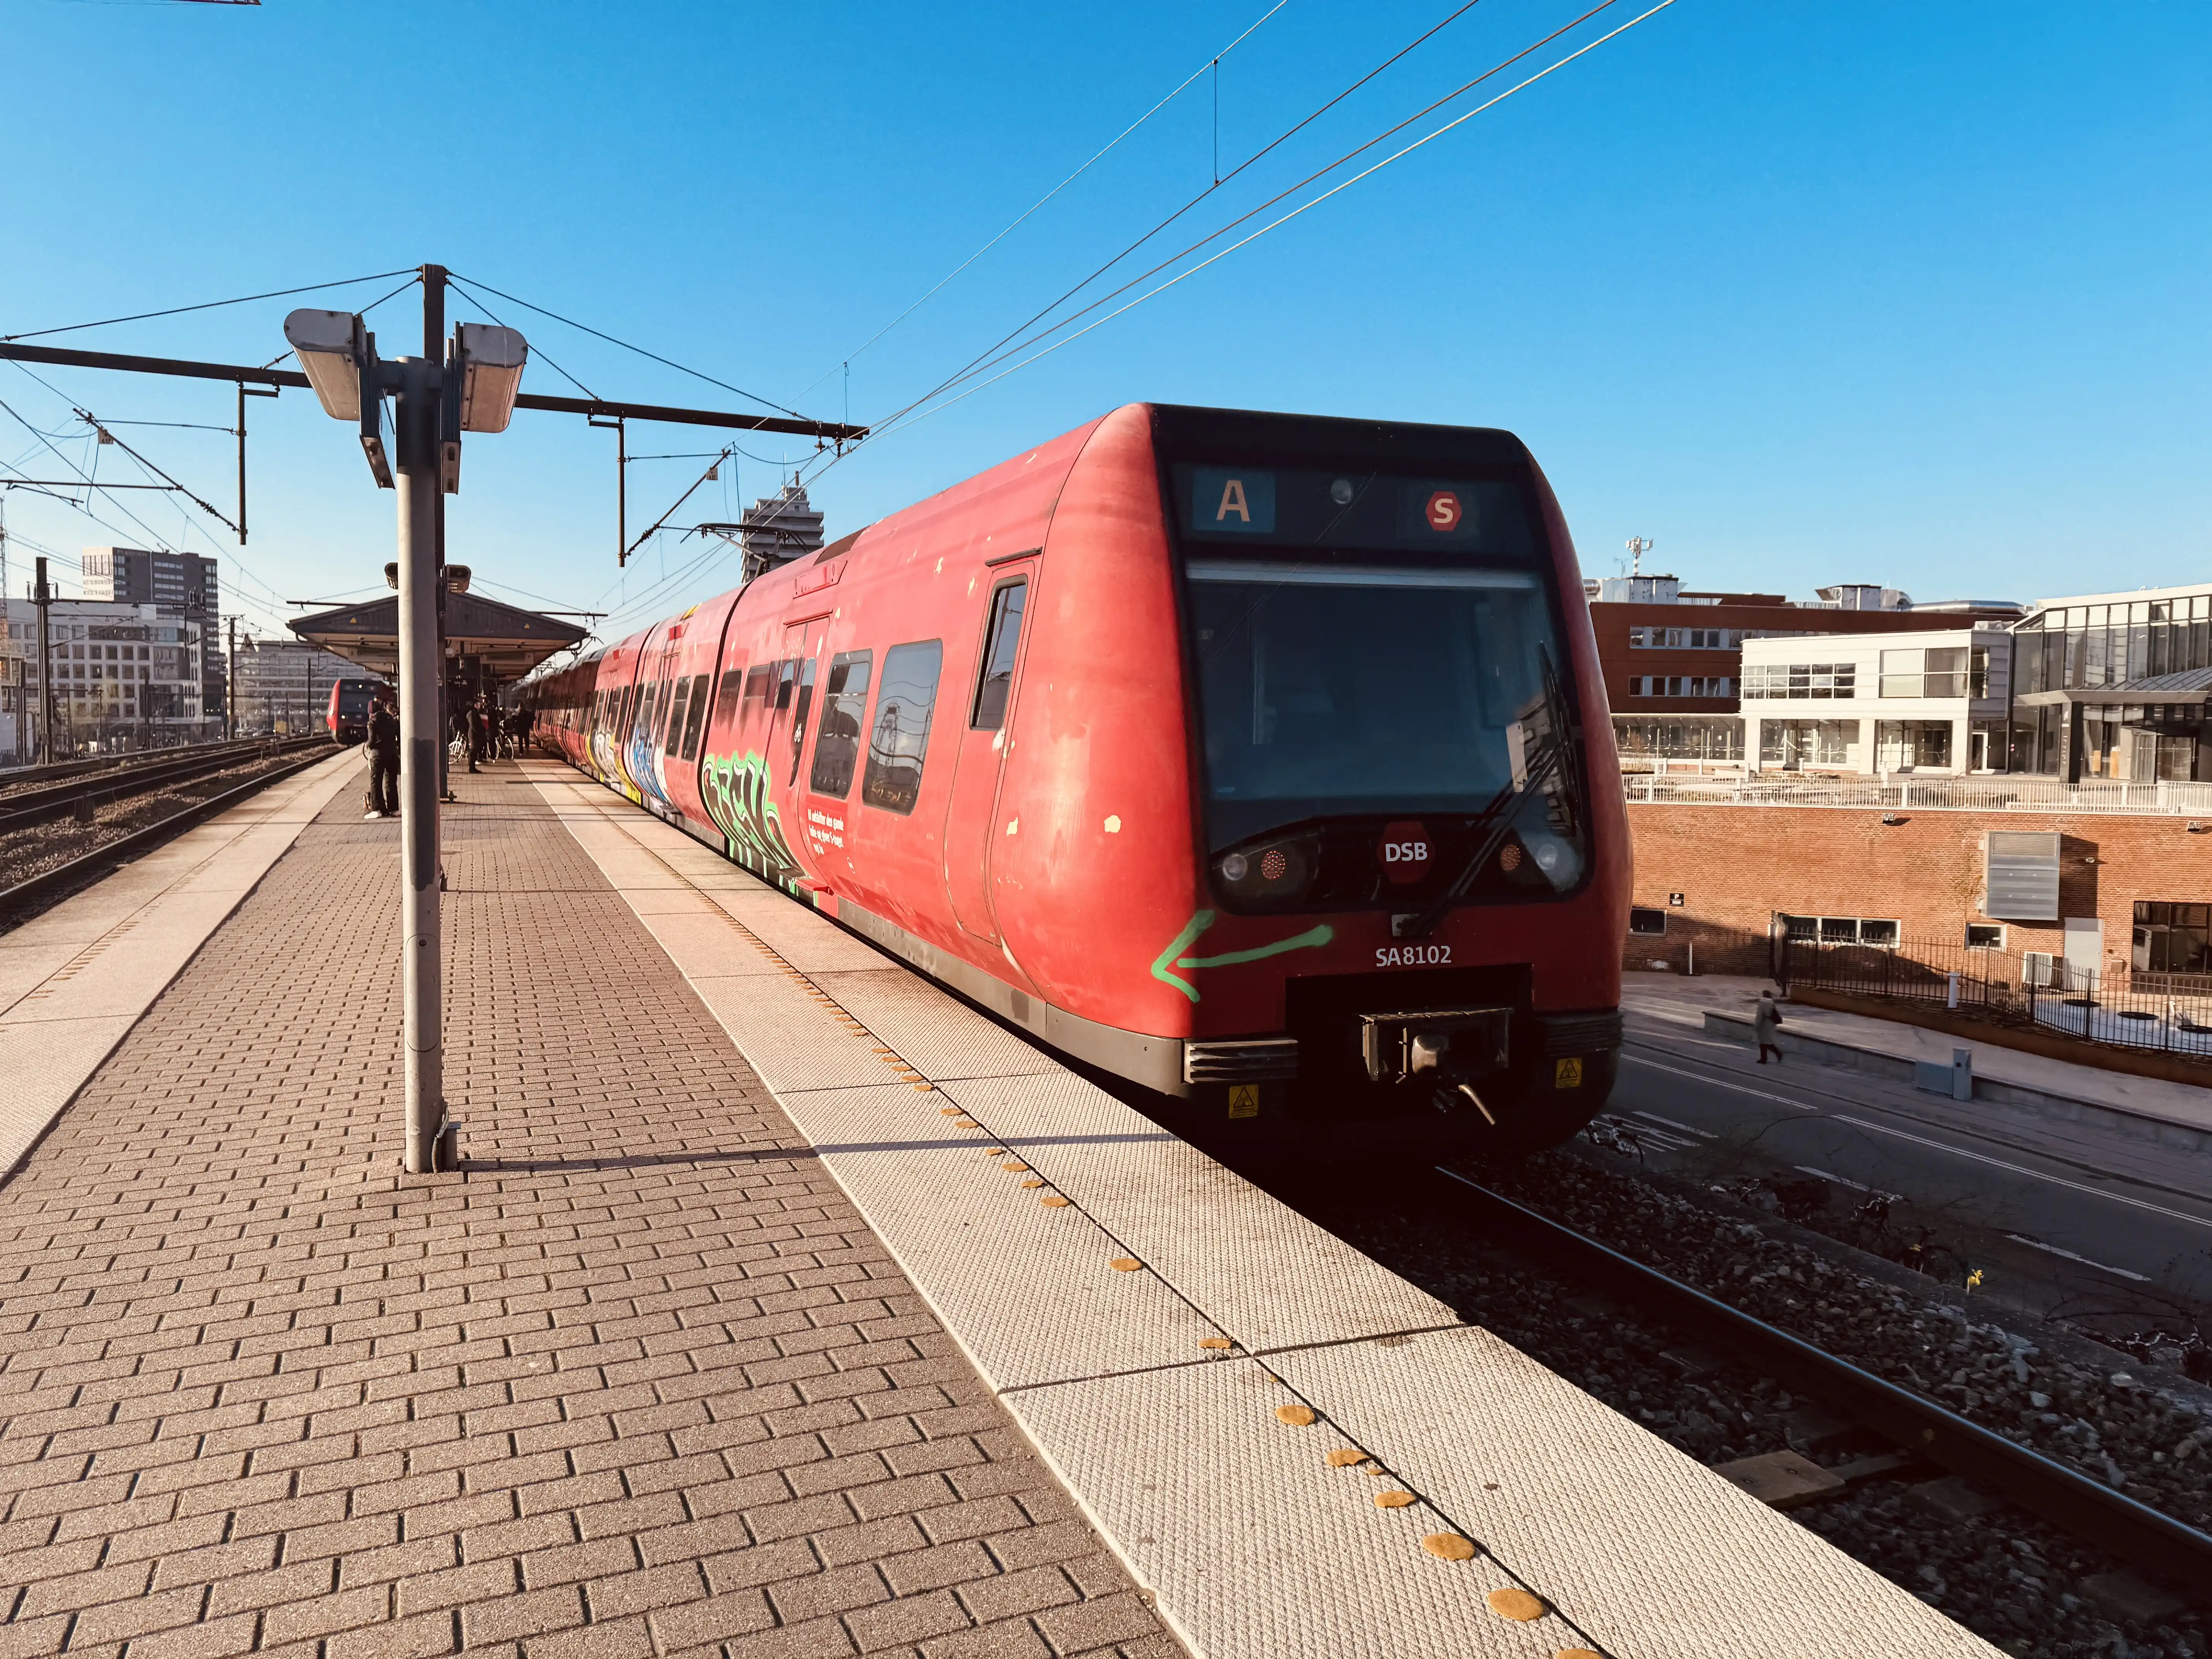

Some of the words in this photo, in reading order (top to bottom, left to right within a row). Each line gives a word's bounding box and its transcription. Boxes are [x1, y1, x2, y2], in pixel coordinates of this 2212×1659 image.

[1216, 480, 1250, 522] A
[1434, 498, 1453, 523] S
[1385, 842, 1427, 862] DSB
